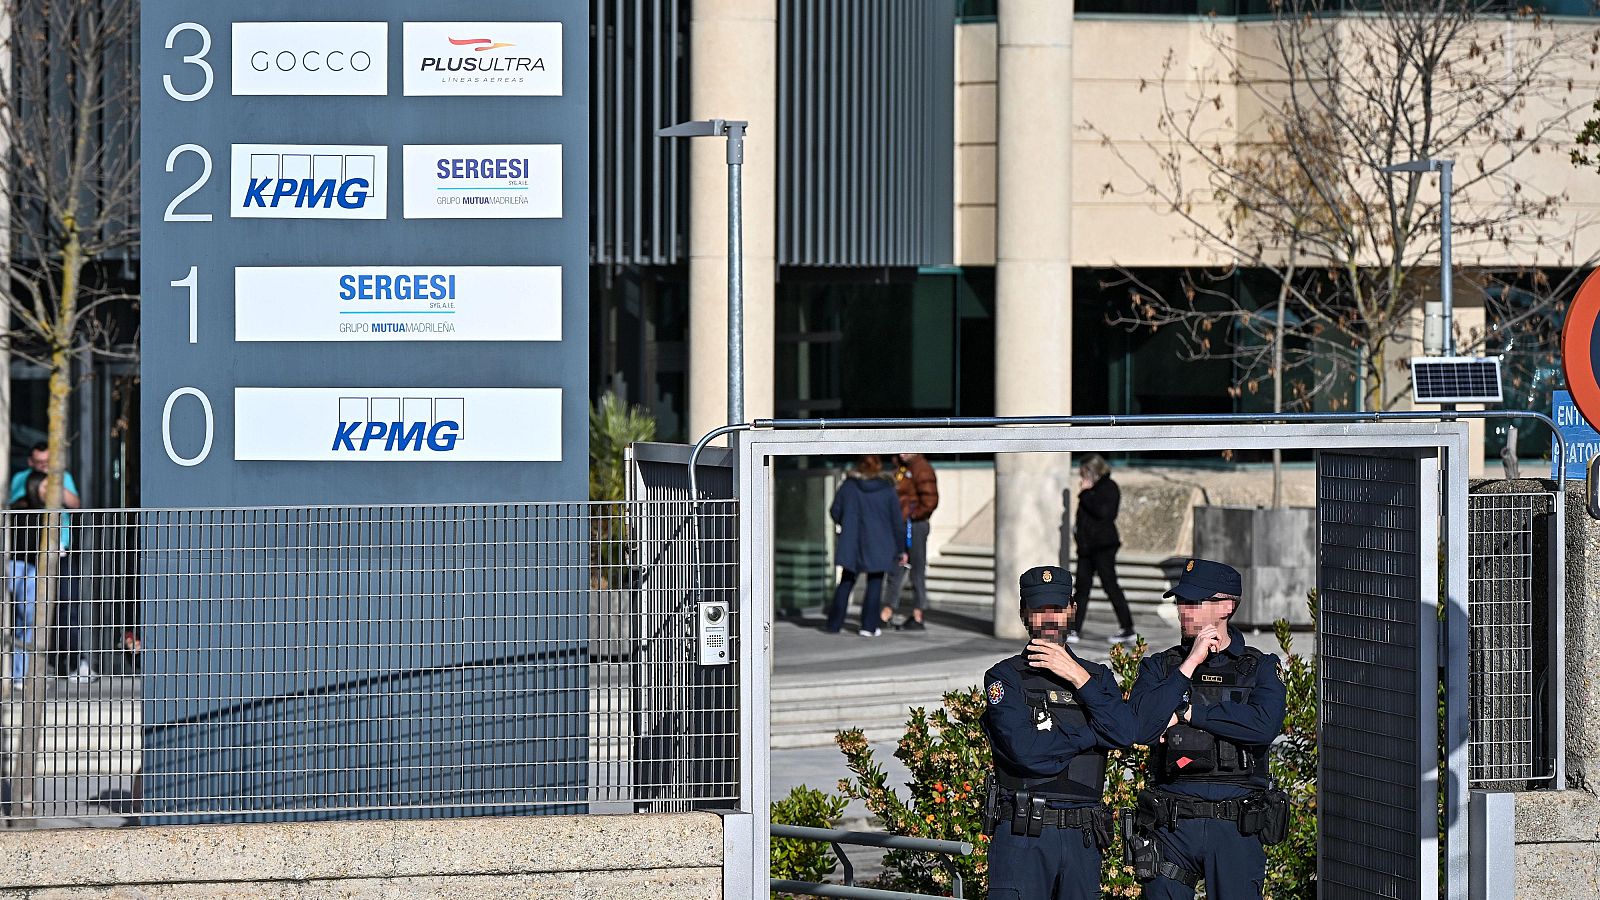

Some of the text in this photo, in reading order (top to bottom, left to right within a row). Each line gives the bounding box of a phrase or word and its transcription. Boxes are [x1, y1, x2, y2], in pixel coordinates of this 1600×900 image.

[164, 23, 213, 101] 3
[251, 51, 371, 71] GOCCO
[164, 144, 213, 222] 2
[437, 159, 529, 179] SERGESI
[243, 178, 369, 209] KPMG
[437, 197, 461, 205] GRUPO
[339, 275, 455, 300] SERGESI
[171, 266, 198, 343] 1
[340, 323, 369, 333] GRUPO
[162, 387, 214, 467] 0
[332, 420, 459, 451] KPMG
